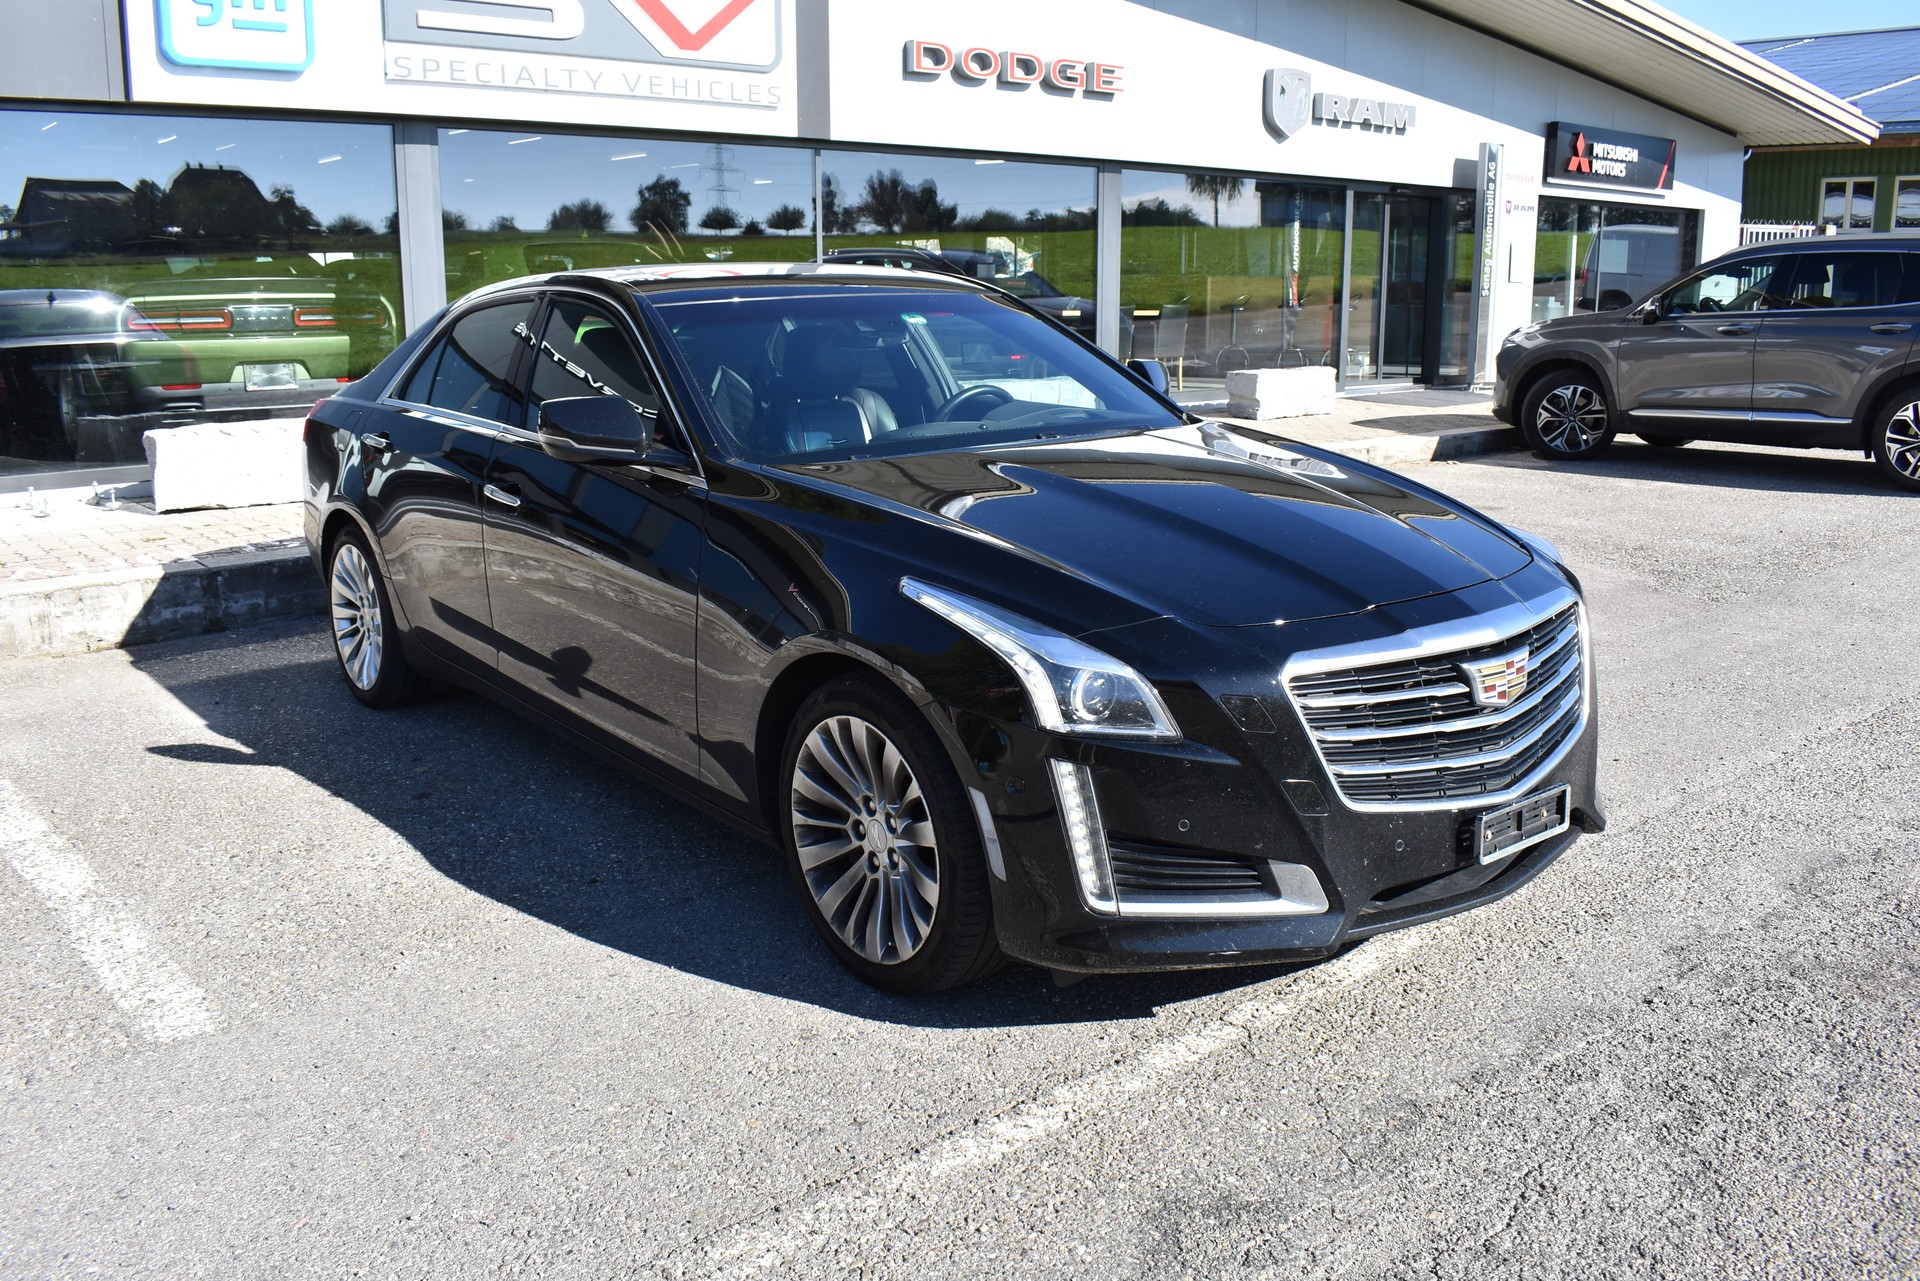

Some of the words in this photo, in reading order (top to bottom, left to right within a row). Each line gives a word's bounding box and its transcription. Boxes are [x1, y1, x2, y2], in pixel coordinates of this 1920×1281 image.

[393, 55, 604, 91] SPECIALTY
[622, 72, 782, 105] VEHICLES
[905, 40, 1124, 96] DODGE
[1315, 93, 1417, 131] RAM
[1593, 142, 1639, 163] MITSUBISHI
[1488, 161, 1496, 179] AG
[1505, 173, 1536, 183] DODGE
[1592, 159, 1627, 178] MOTORS
[1484, 182, 1496, 256] Automobile
[1513, 204, 1535, 213] RAM
[1482, 258, 1493, 297] Senag
